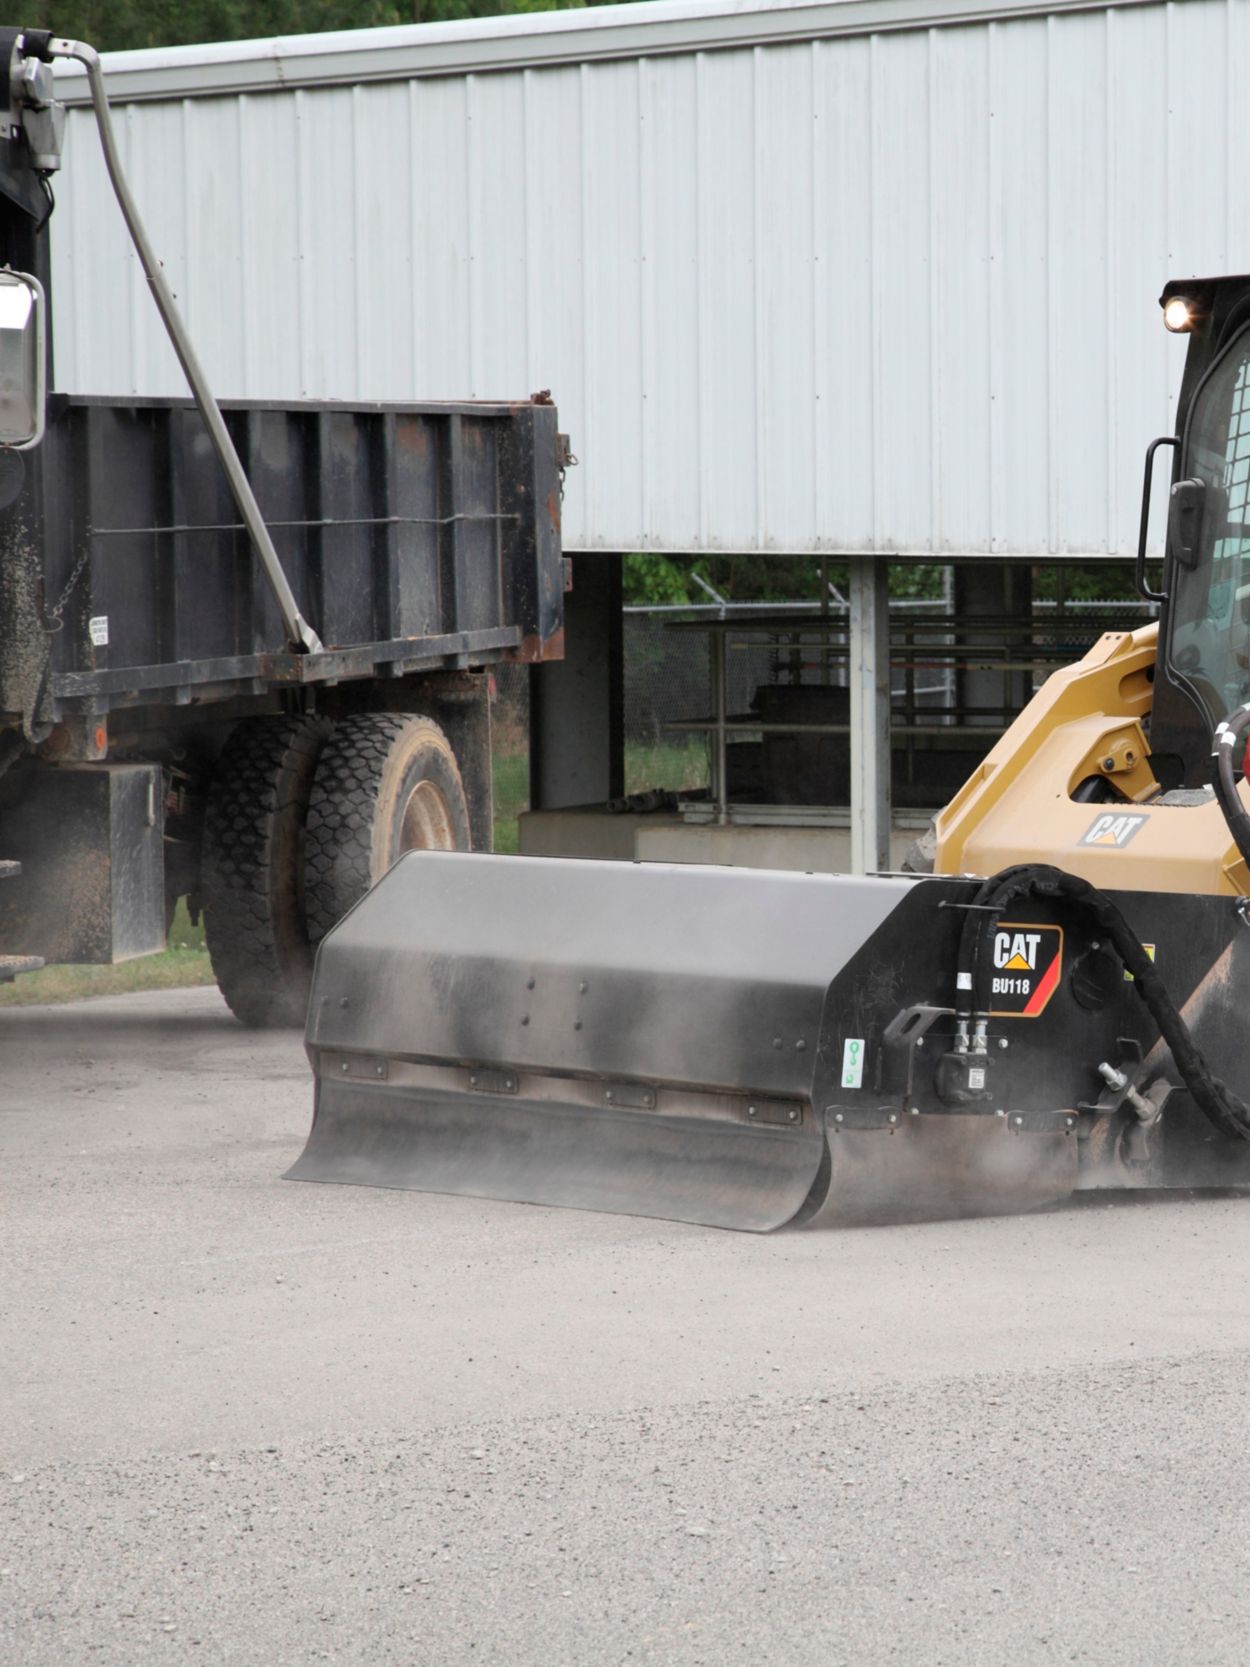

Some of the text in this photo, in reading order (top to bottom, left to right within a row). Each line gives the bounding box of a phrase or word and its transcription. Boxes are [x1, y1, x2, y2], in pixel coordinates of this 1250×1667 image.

[1085, 815, 1143, 845] CAT
[993, 932, 1041, 970] CAT
[992, 977, 1031, 995] BU118
